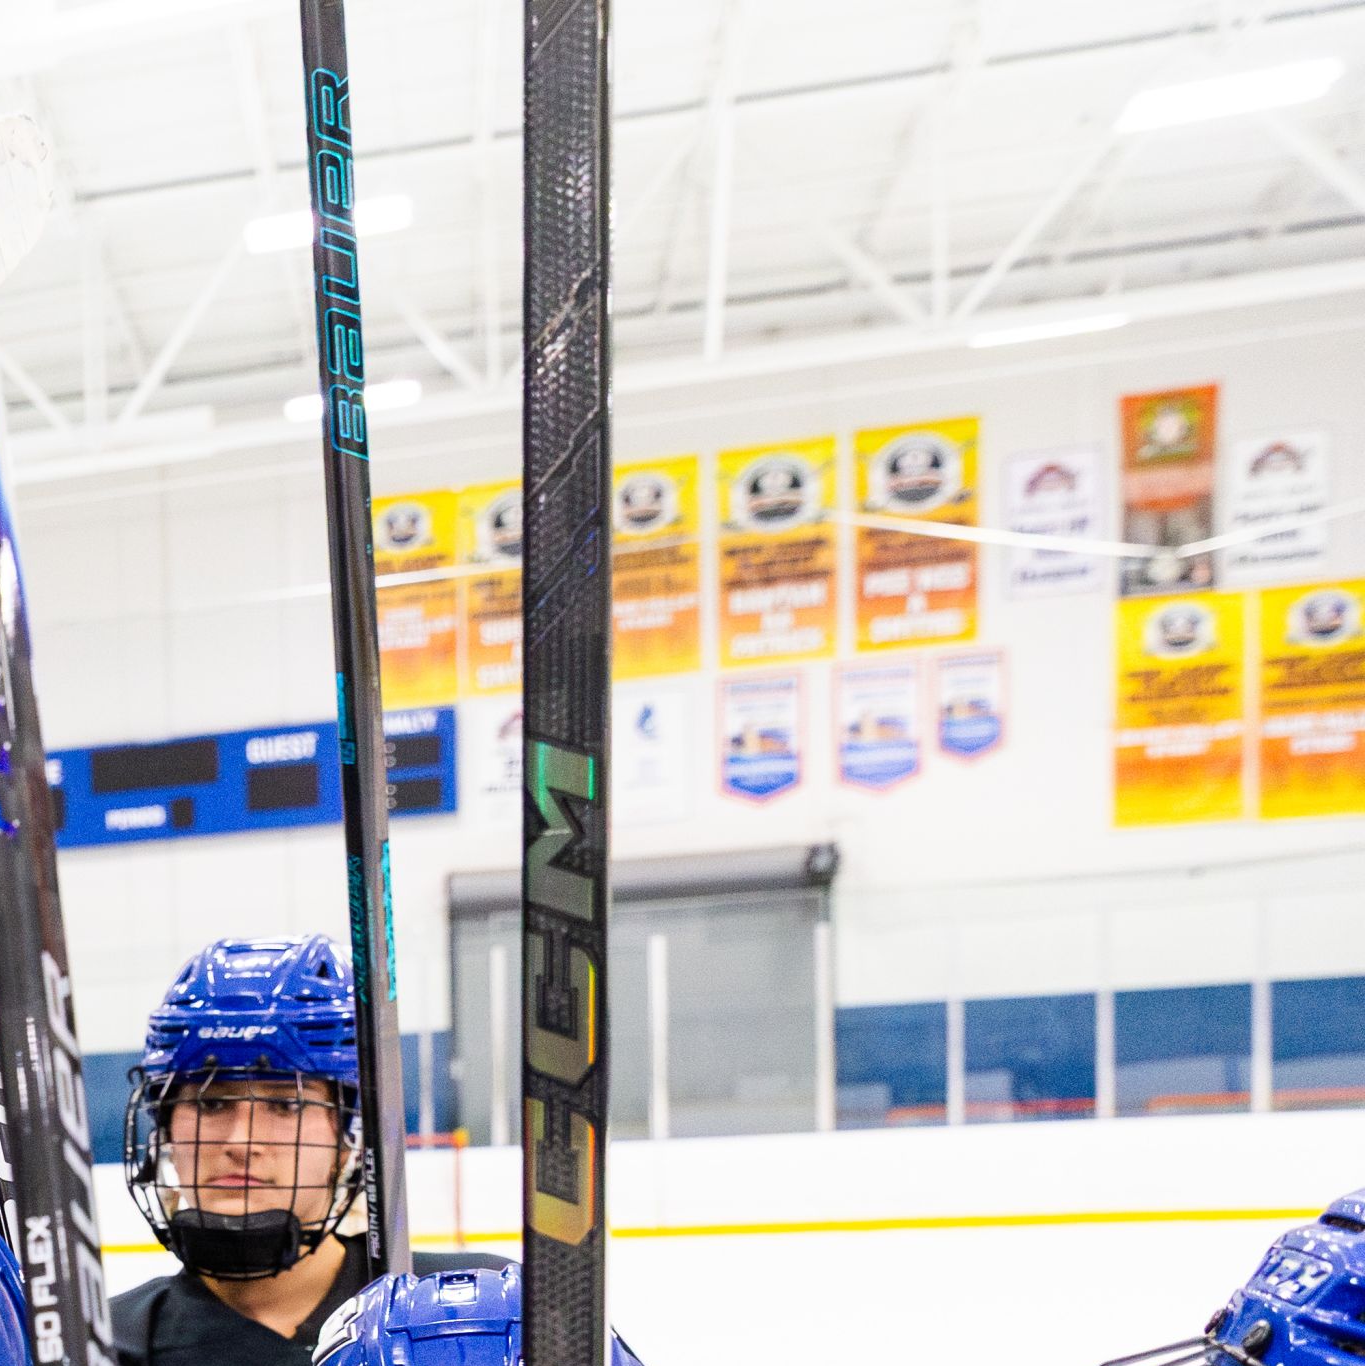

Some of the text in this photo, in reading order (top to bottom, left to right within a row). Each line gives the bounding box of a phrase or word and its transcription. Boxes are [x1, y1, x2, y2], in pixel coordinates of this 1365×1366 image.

[310, 67, 371, 461] BAUER
[525, 740, 595, 1246] CCM
[25, 1215, 57, 1305] FLEX
[364, 1147, 376, 1183] FLEX
